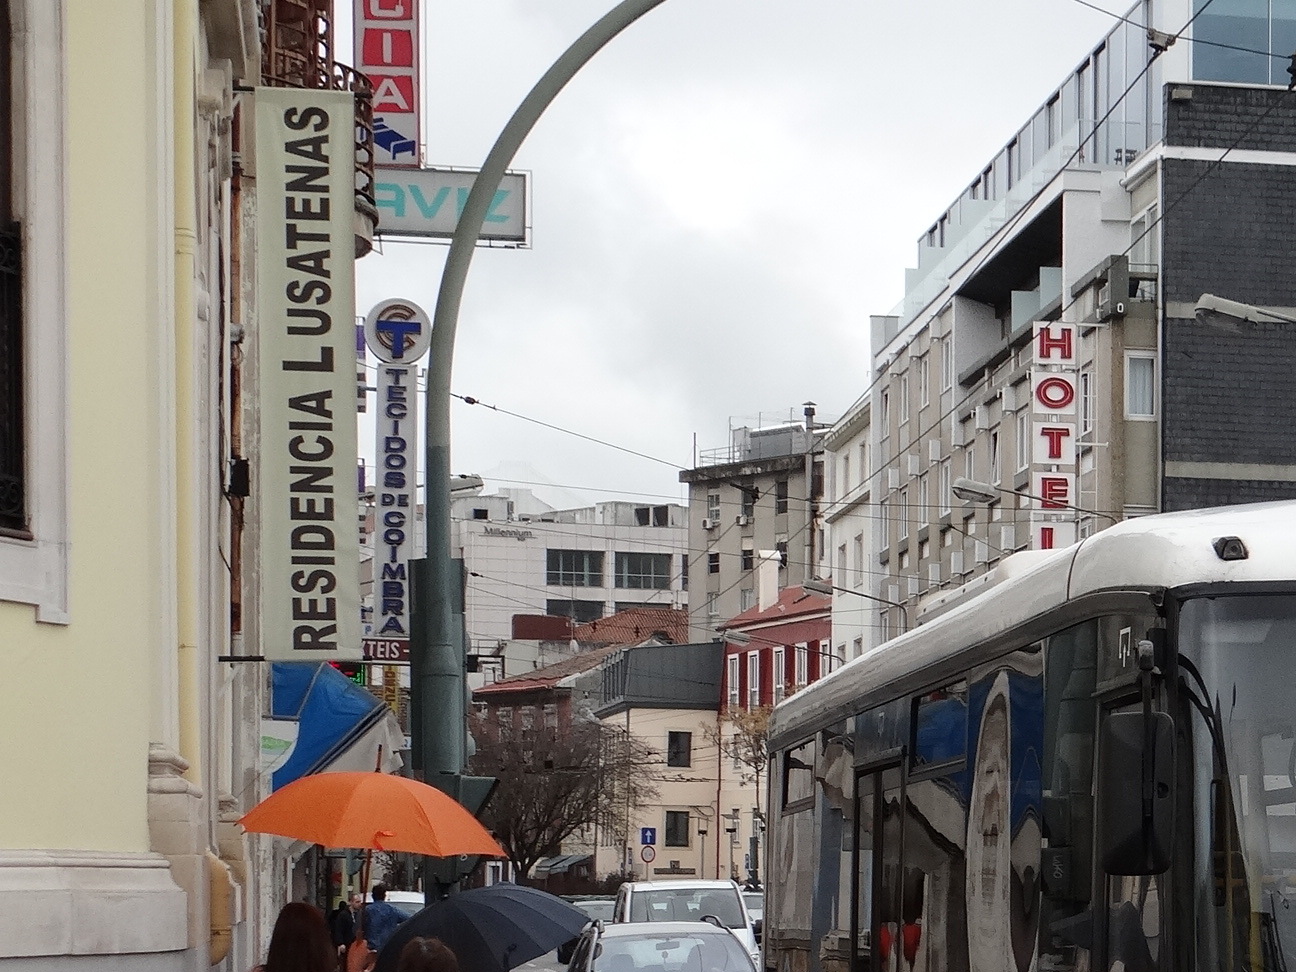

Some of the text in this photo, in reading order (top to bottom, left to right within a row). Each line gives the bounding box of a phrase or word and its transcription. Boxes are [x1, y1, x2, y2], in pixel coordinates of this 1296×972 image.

[384, 368, 409, 489] TECIDOS
[289, 389, 338, 651] RESIDENCIA
[381, 494, 409, 507] DE
[380, 511, 406, 634] COIMBRA
